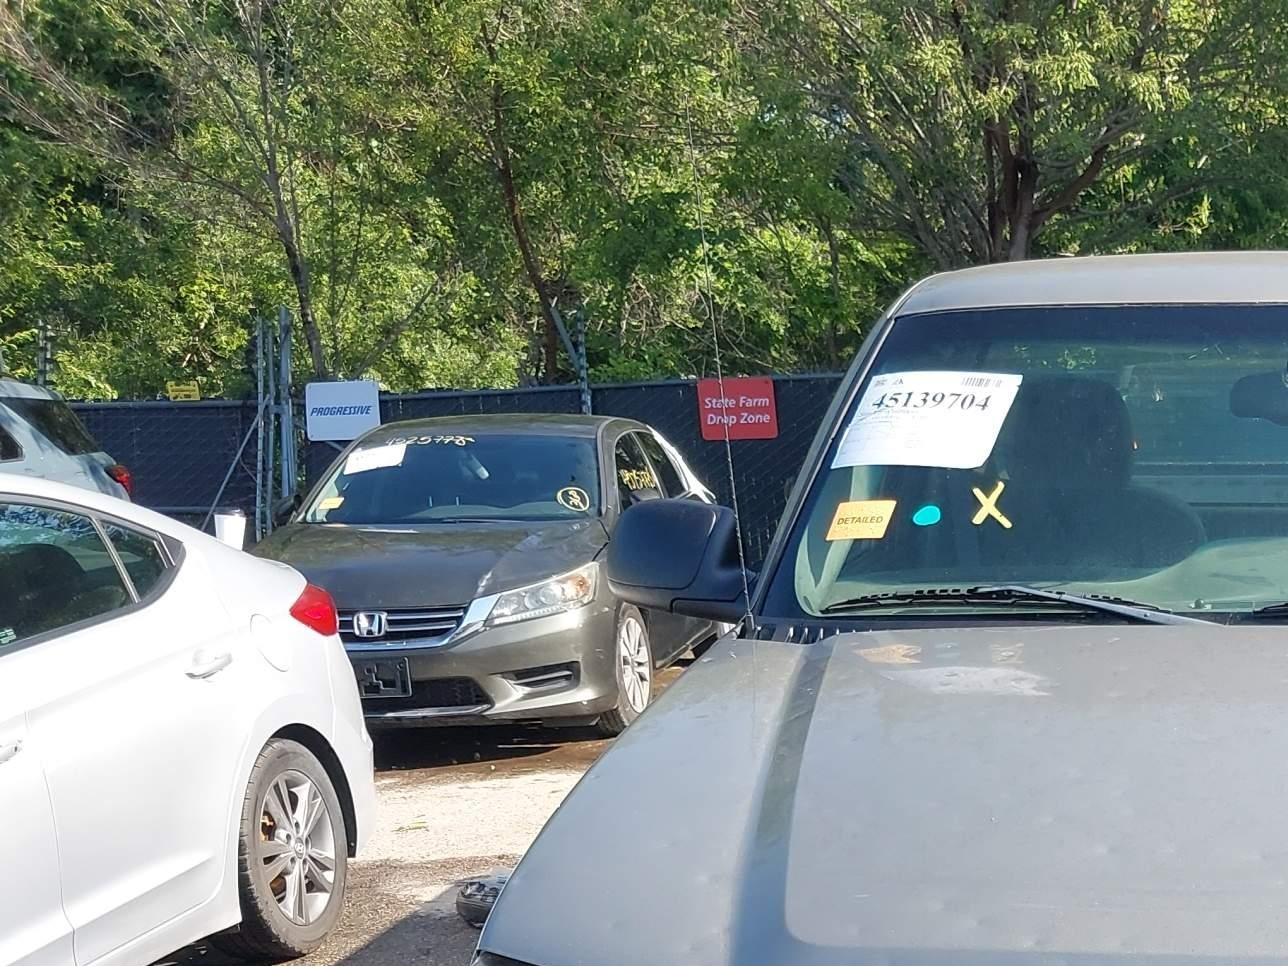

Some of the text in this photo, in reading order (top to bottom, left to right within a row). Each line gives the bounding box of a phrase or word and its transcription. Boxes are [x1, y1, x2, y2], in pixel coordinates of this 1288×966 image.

[704, 396, 769, 409] State Farm
[872, 391, 992, 411] 45139704
[310, 405, 372, 417] PROGRESSIVE
[707, 412, 771, 427] Drop Zone
[837, 515, 884, 526] DETAILED
